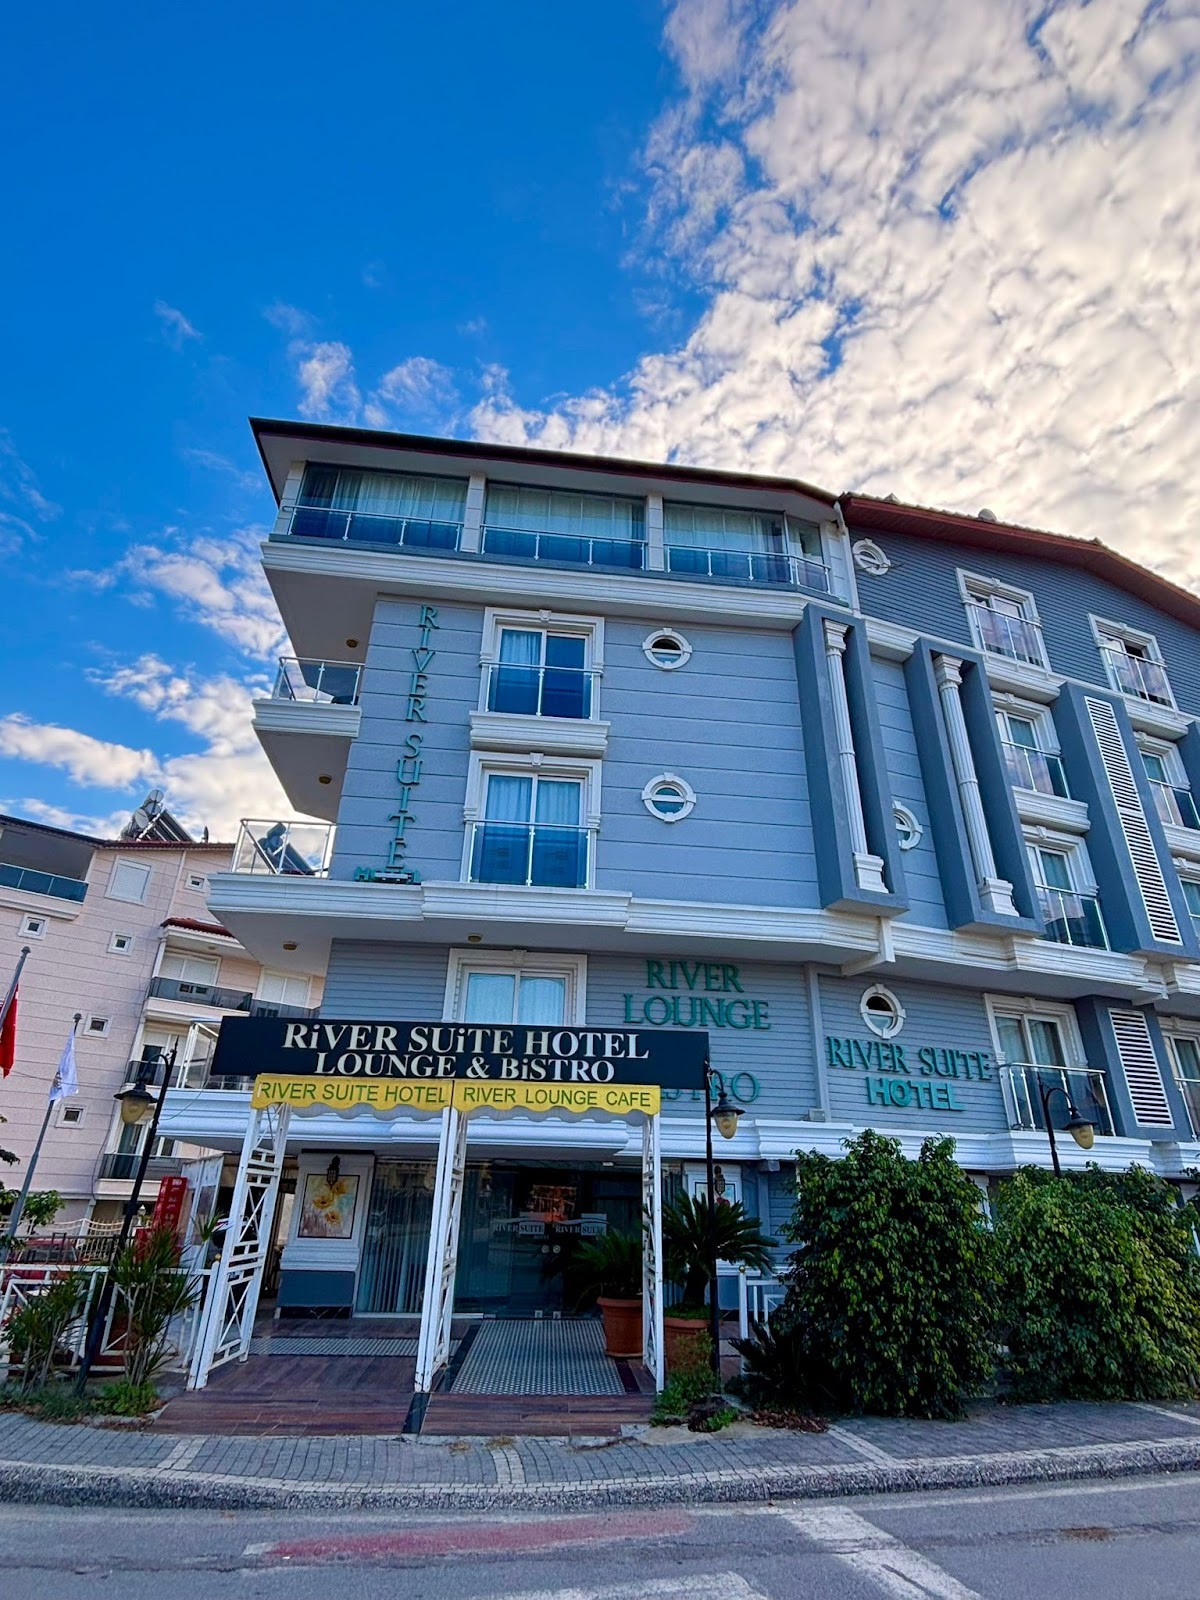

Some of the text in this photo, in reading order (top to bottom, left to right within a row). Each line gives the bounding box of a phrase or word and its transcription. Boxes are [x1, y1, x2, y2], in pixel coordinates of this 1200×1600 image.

[405, 604, 439, 722] RIVER
[388, 734, 424, 869] SUITE
[646, 959, 744, 992] RIVER
[624, 994, 771, 1029] LOUNGE
[525, 1031, 649, 1059] HOTEL
[828, 1037, 993, 1080] RIVER SUITE
[315, 1053, 456, 1077] LOUNGE
[466, 1057, 490, 1079] &
[259, 1082, 447, 1104] RIVER SUITE HOTEL
[463, 1088, 651, 1107] RIVER LOUNGE CAFE
[867, 1076, 966, 1111] HOTEL
[493, 1224, 543, 1233] RIVER SUITE
[555, 1226, 581, 1234] RIVER
